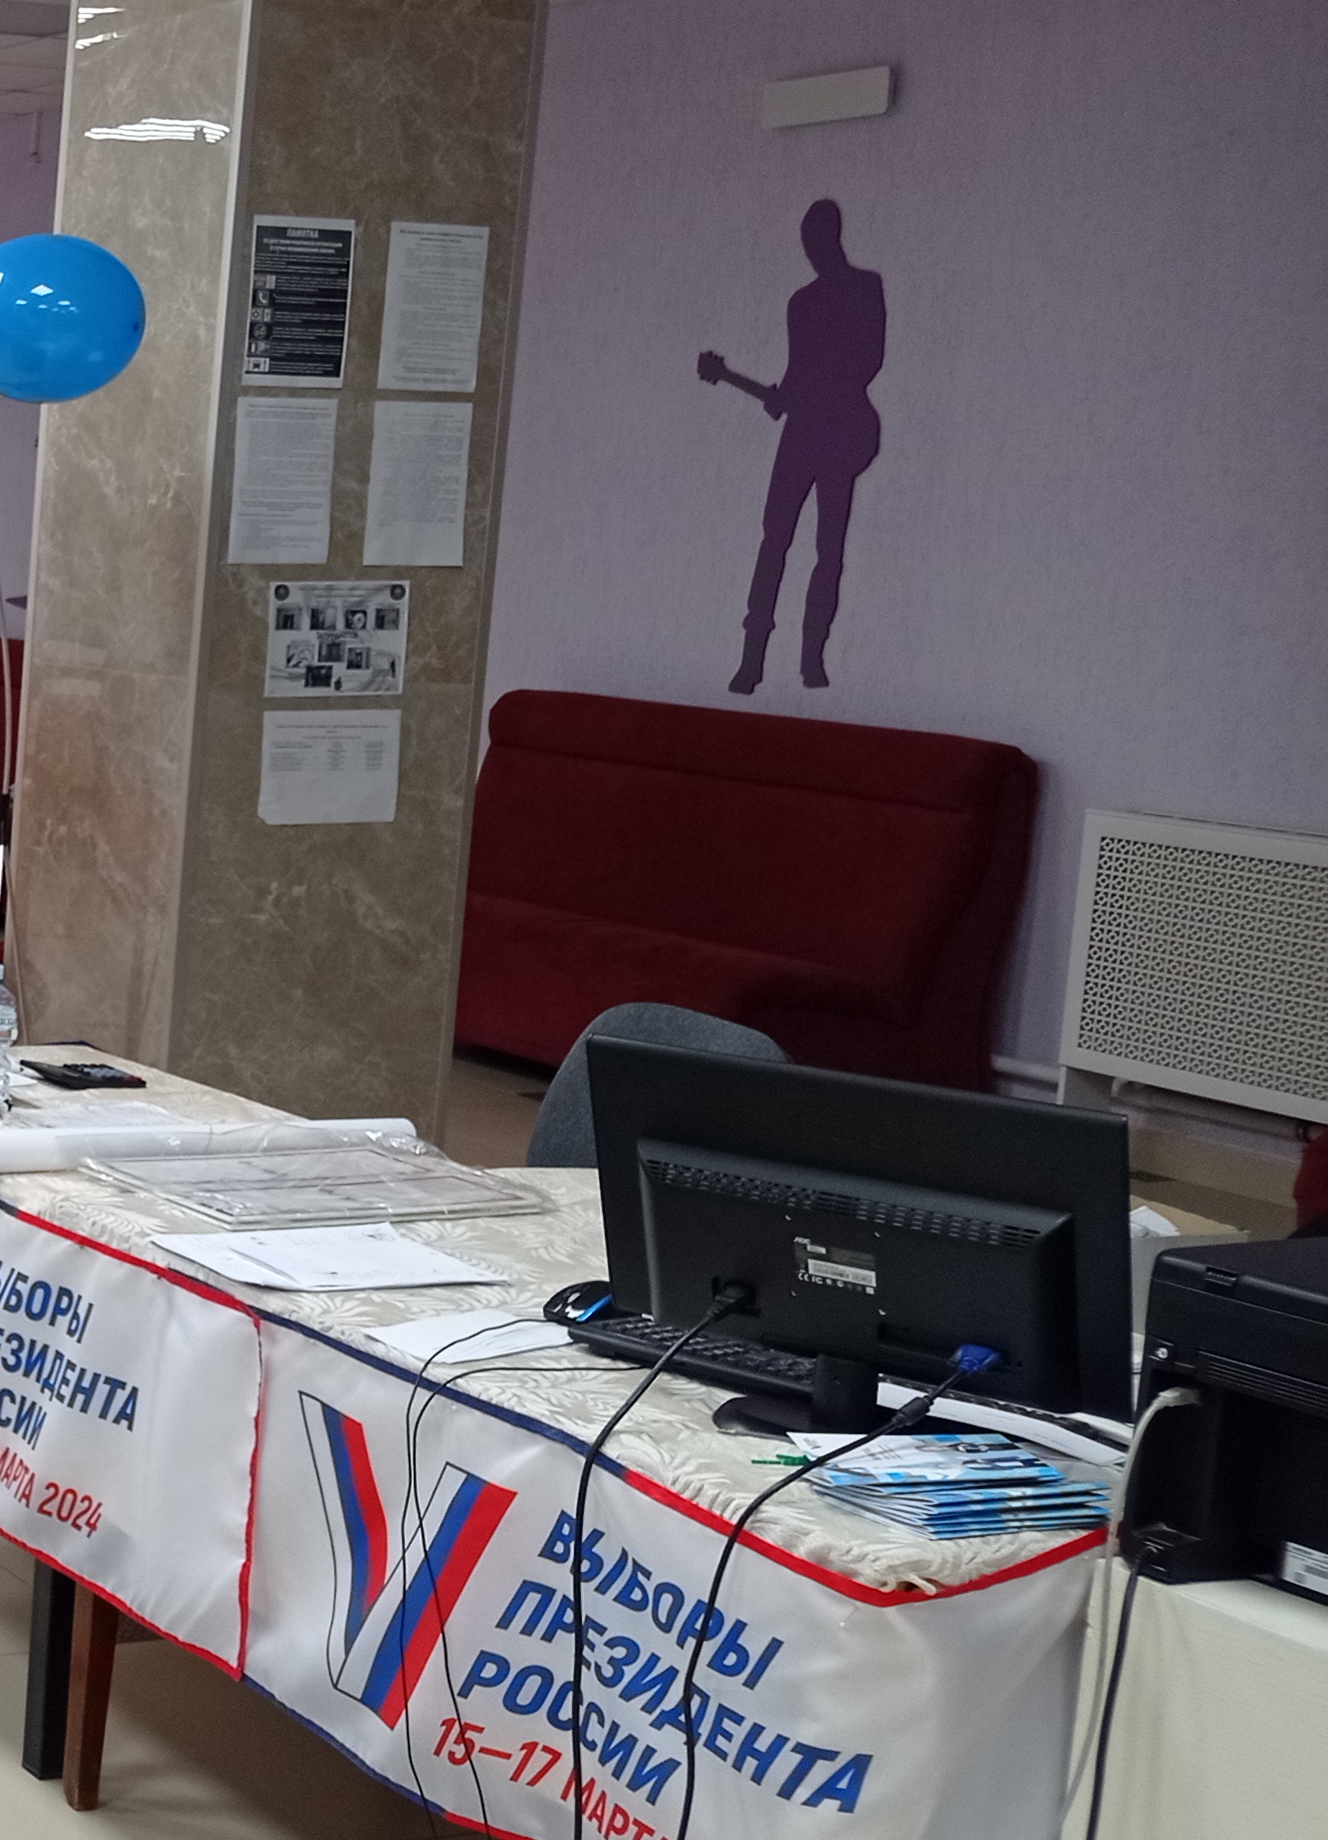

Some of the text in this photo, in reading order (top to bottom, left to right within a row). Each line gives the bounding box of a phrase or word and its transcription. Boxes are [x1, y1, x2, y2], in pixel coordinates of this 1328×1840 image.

[37, 1481, 104, 1538] 2024
[537, 1509, 784, 1691] ВЫБОРЫ
[457, 1649, 682, 1807] РОССИИ
[495, 1579, 874, 1814] ПРЕЗИДЕНТА
[559, 1768, 676, 1840] МАРТ
